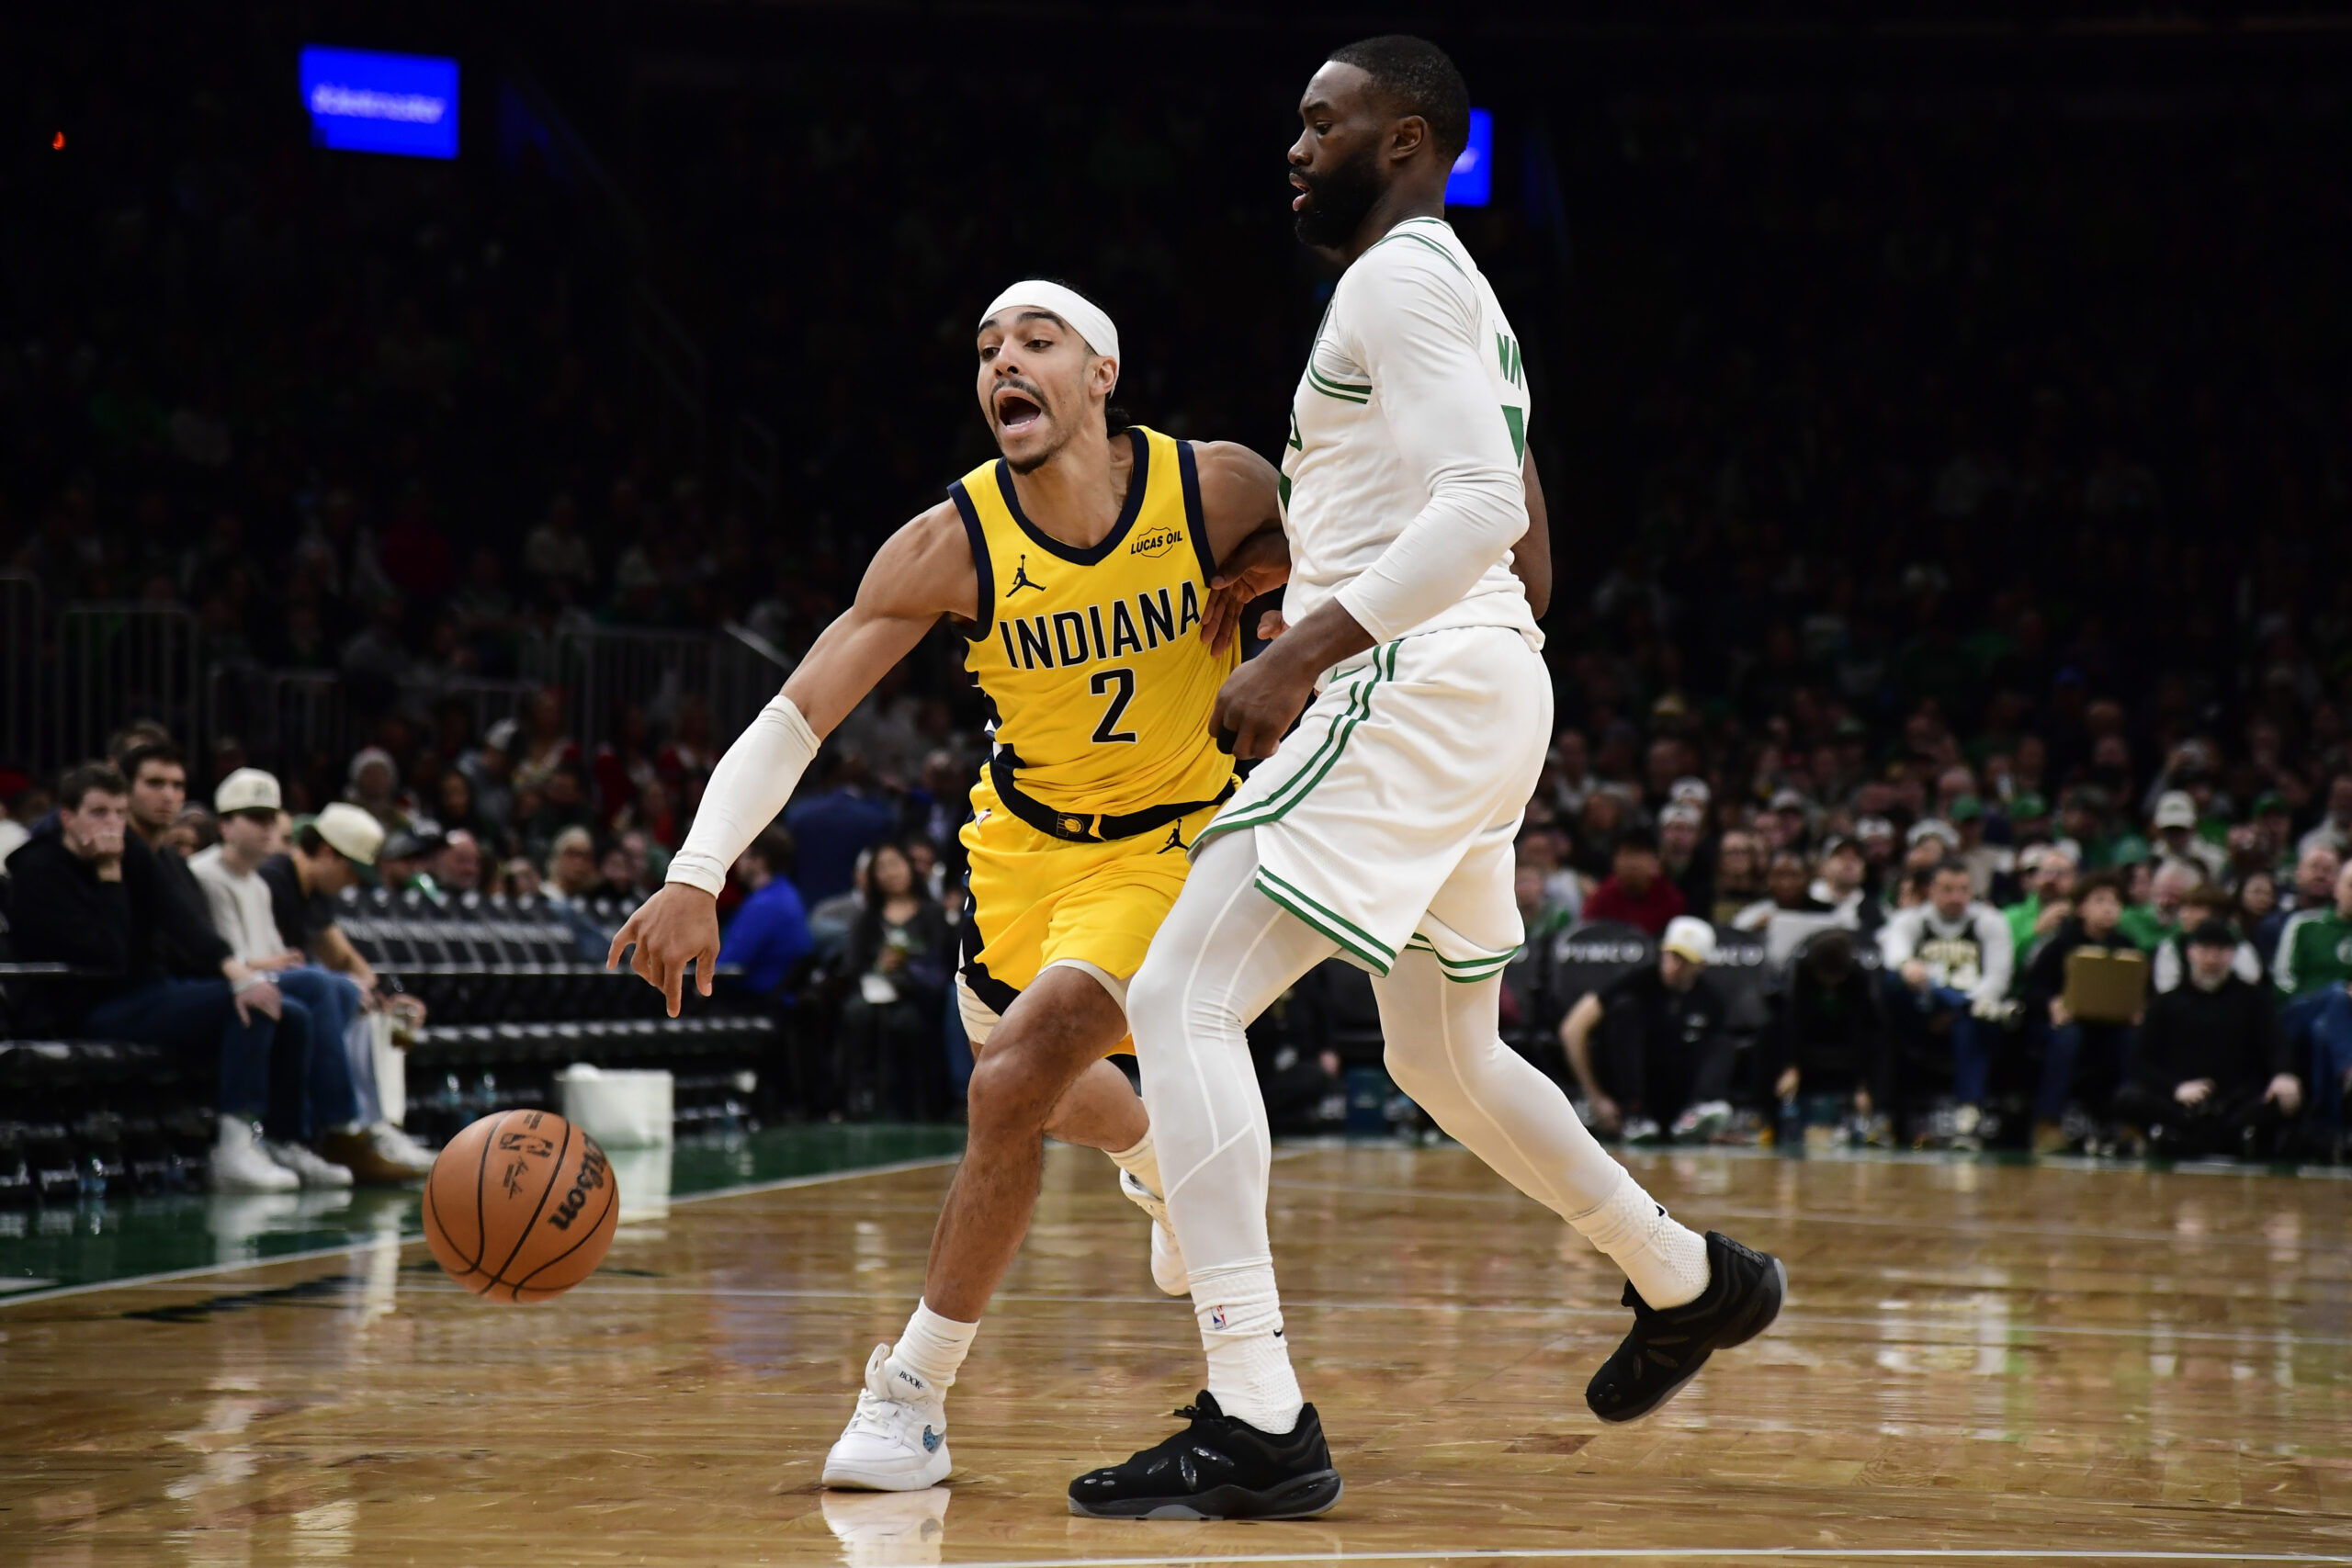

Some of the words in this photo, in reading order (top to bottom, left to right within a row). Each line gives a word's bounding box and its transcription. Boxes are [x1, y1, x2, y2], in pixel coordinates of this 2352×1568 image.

[1130, 536, 1163, 555] LUCAS
[1166, 530, 1183, 545] OIL
[999, 581, 1201, 670] INDIANA
[1090, 668, 1137, 744] 2
